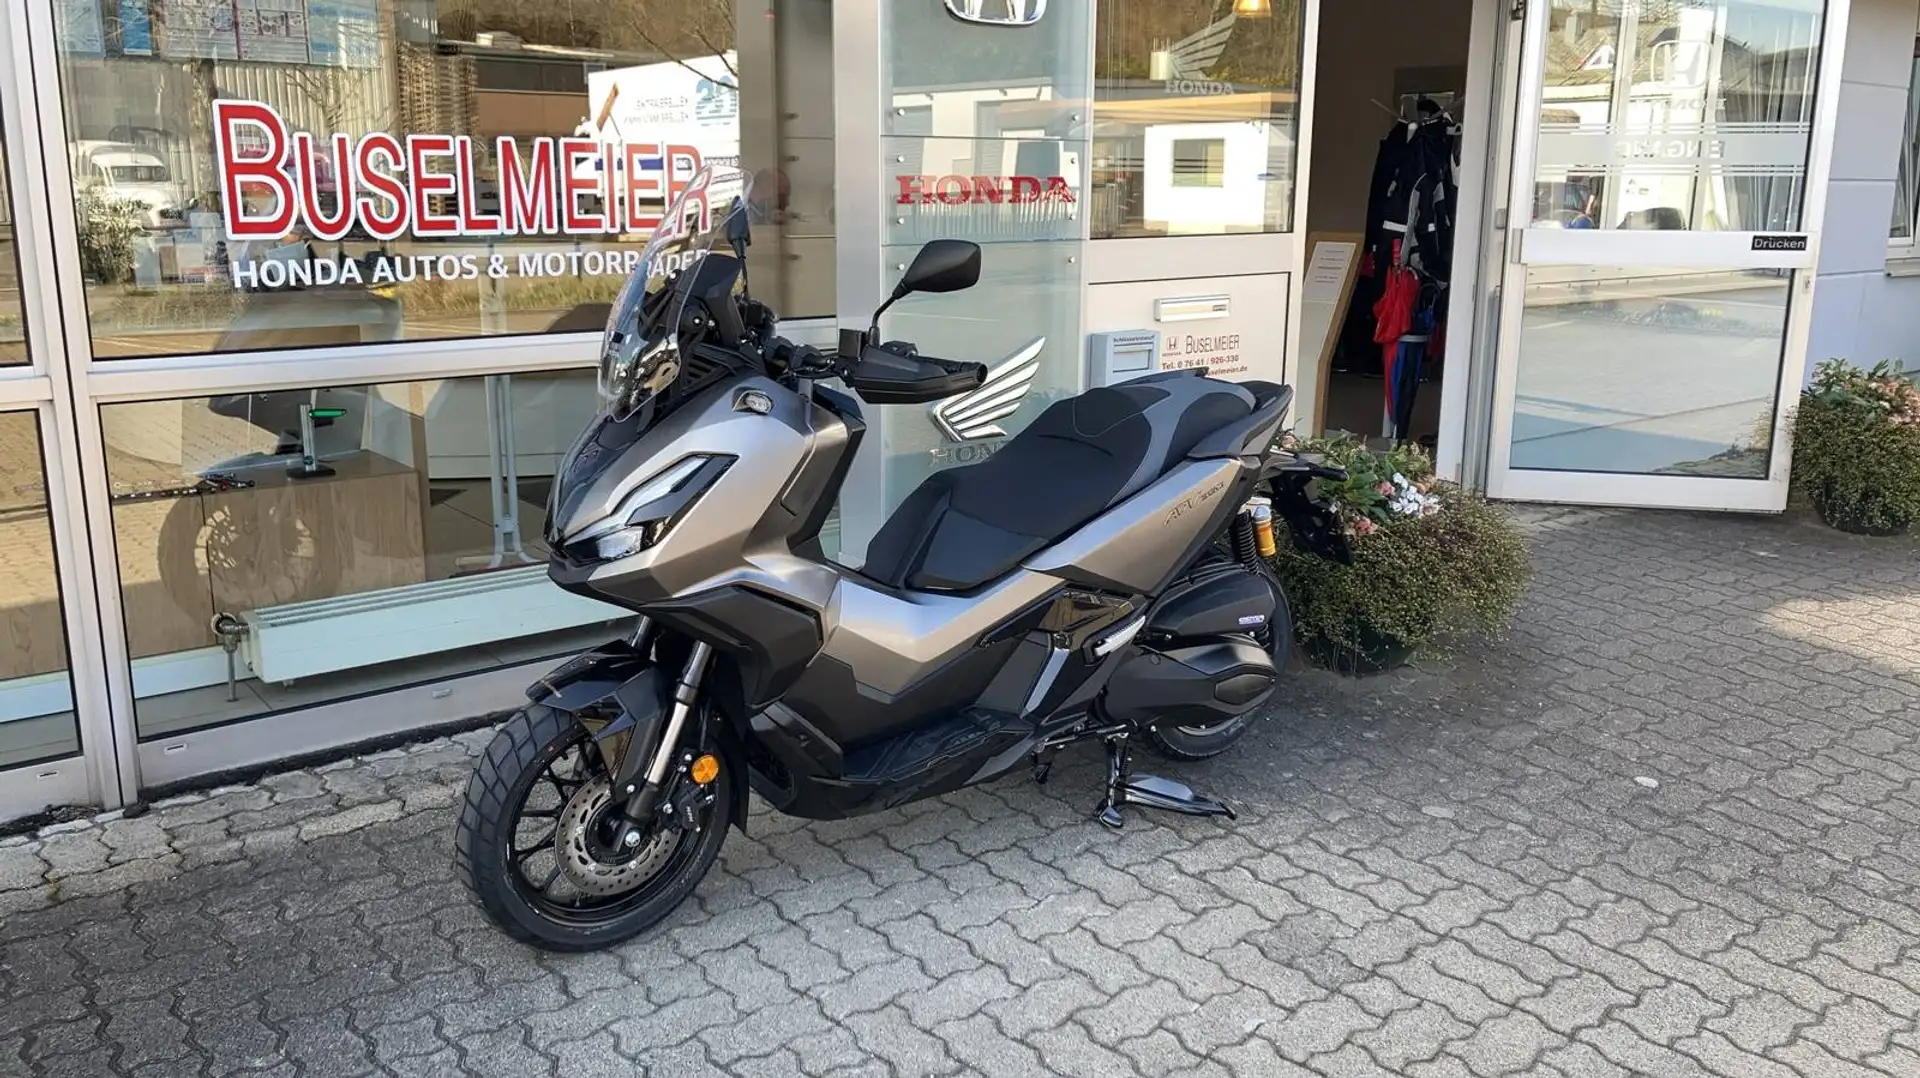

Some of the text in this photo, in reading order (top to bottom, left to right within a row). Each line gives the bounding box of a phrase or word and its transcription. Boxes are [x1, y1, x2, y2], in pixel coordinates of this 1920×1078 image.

[1164, 80, 1235, 96] HONDA
[895, 174, 1076, 206] HONDA
[1754, 237, 1805, 249] Drücken
[232, 256, 363, 288] HONDA
[372, 253, 479, 284] AUTOS
[487, 252, 509, 279] &
[1185, 334, 1239, 354] BUSELMEIER
[929, 442, 1007, 467] HON
